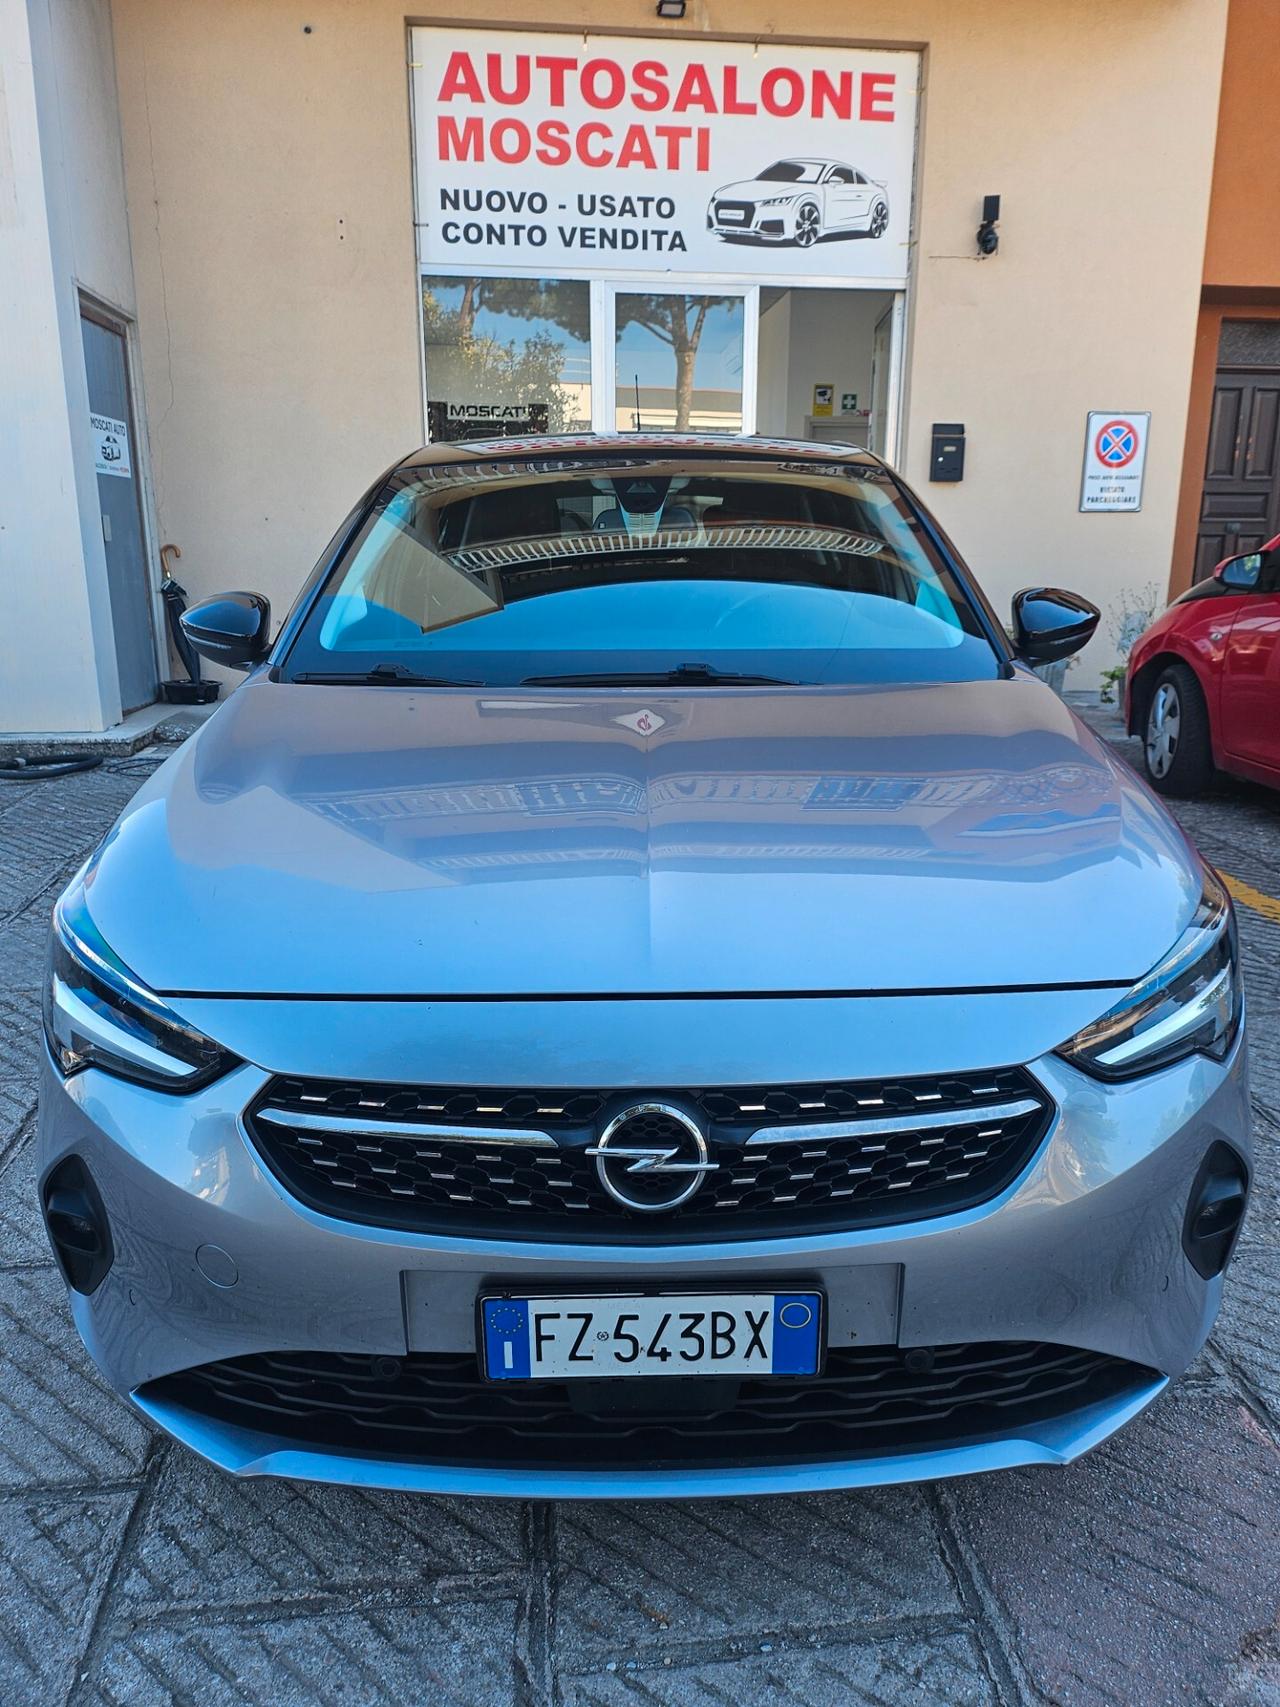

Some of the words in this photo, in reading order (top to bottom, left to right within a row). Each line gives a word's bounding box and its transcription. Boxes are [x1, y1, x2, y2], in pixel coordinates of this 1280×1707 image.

[438, 51, 896, 122] AUTOSALONE
[438, 116, 711, 172] MOSCATI
[440, 188, 548, 214] NUOVO
[577, 195, 676, 219] USATO
[441, 221, 548, 246] CONTO
[559, 226, 688, 252] VENDITA
[90, 416, 113, 433] MOSCATI
